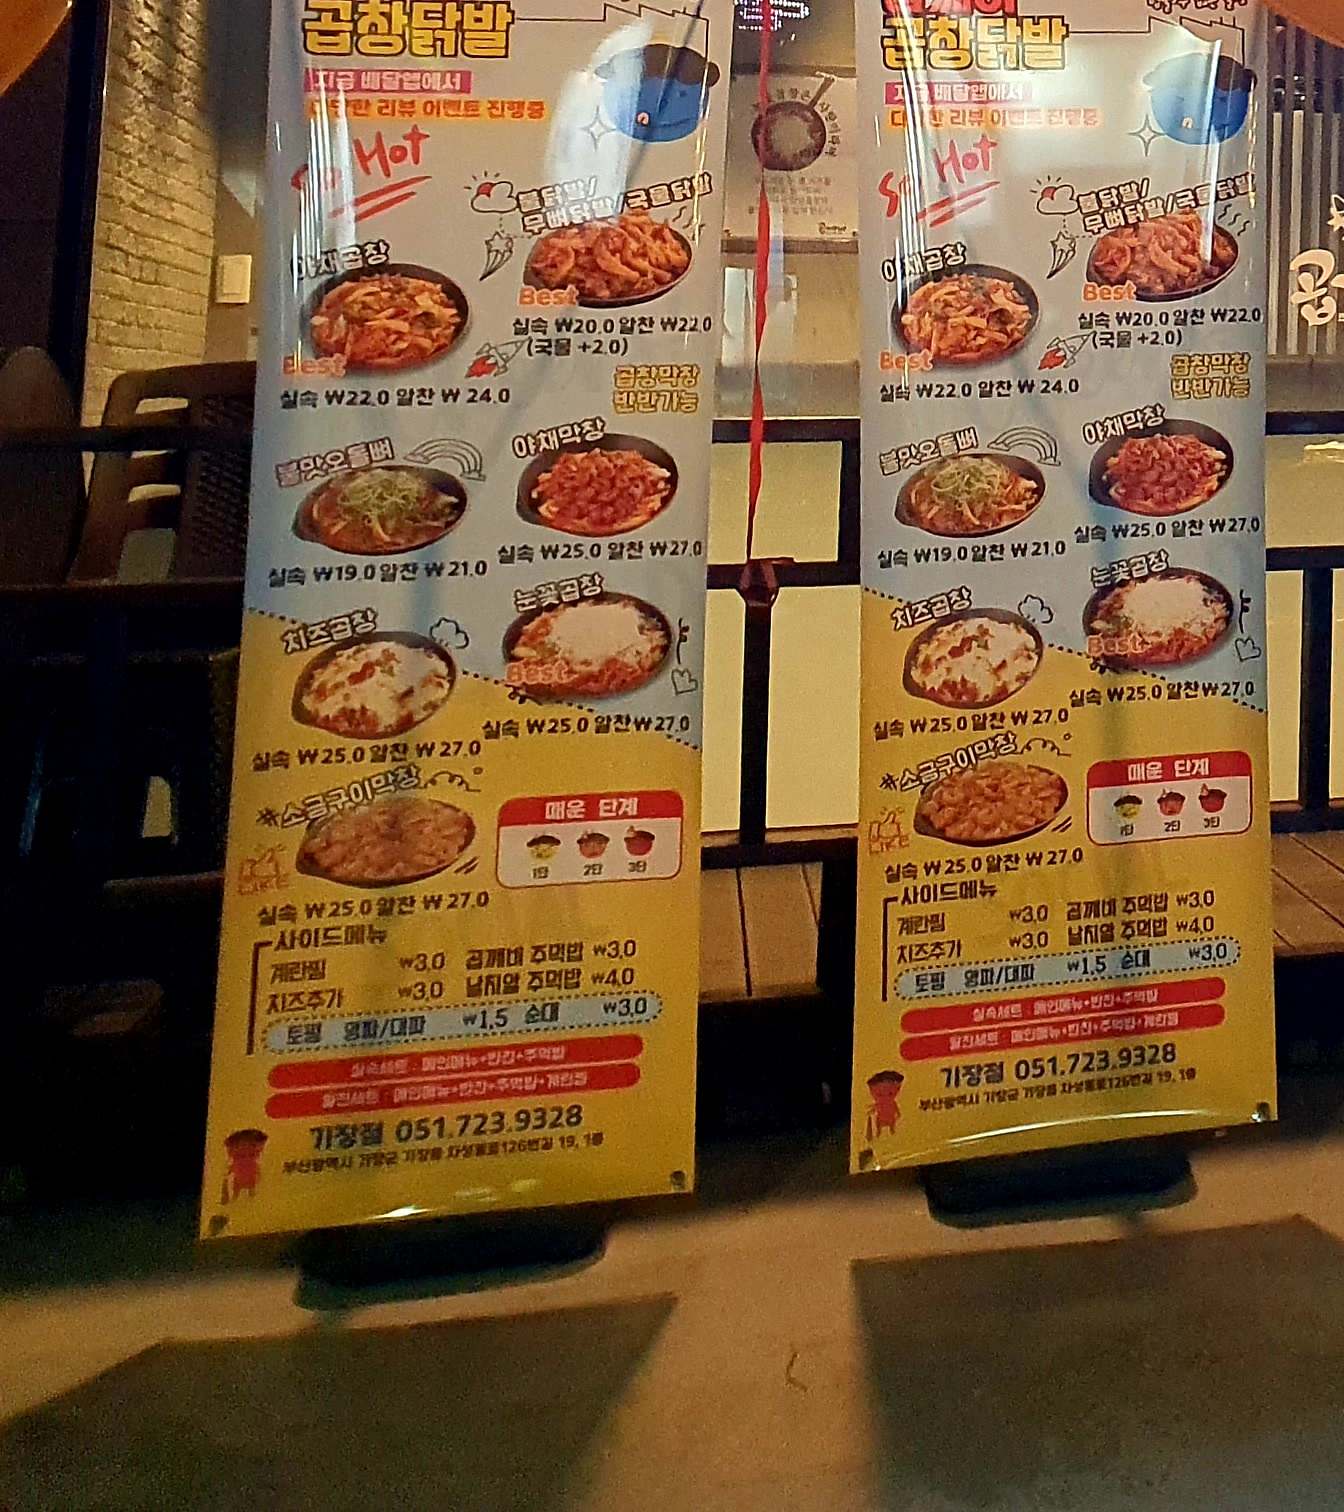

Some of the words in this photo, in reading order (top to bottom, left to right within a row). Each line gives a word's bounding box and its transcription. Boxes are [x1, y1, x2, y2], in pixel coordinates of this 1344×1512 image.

[303, 0, 512, 59] 곱창닭발
[881, 15, 1069, 70] 곱창닭발
[377, 99, 417, 118] 리뷰
[422, 99, 480, 118] 이벤트
[951, 109, 984, 126] 리뷰
[353, 123, 430, 178] Hot
[933, 134, 997, 183] Hot
[518, 285, 579, 307] Best
[1082, 281, 1137, 302] Best
[578, 338, 629, 357] +2.0)
[1137, 328, 1183, 347] +2.0)
[878, 349, 933, 372] Best
[1170, 352, 1251, 377] 곱창막창
[613, 364, 700, 388] 곱창막창
[1170, 377, 1251, 401] 반반가능
[612, 389, 699, 414] 반반가능
[512, 416, 606, 459] 야채막창
[1082, 403, 1166, 445] 야채막창
[1090, 548, 1170, 589] 눈꽃곱창
[513, 572, 607, 612] 눈꽃곱창
[891, 585, 972, 631] 치즈곱창
[280, 607, 378, 655] 치즈곱창
[900, 730, 1017, 792] 소금구이막창
[1127, 761, 1163, 782] 매운
[1174, 758, 1210, 778] 단계
[281, 762, 421, 828] 소금구이막창
[545, 799, 586, 820] 매운
[599, 797, 638, 817] 단계
[901, 880, 998, 906] 사이드메뉴
[274, 924, 388, 951] 사이드메뉴
[896, 939, 963, 964] 치즈추가
[266, 987, 344, 1015] 치즈추가
[940, 1061, 1004, 1088] 기장점
[1015, 1042, 1177, 1081] 051.723.9328
[395, 1104, 583, 1143] 051.723.9328
